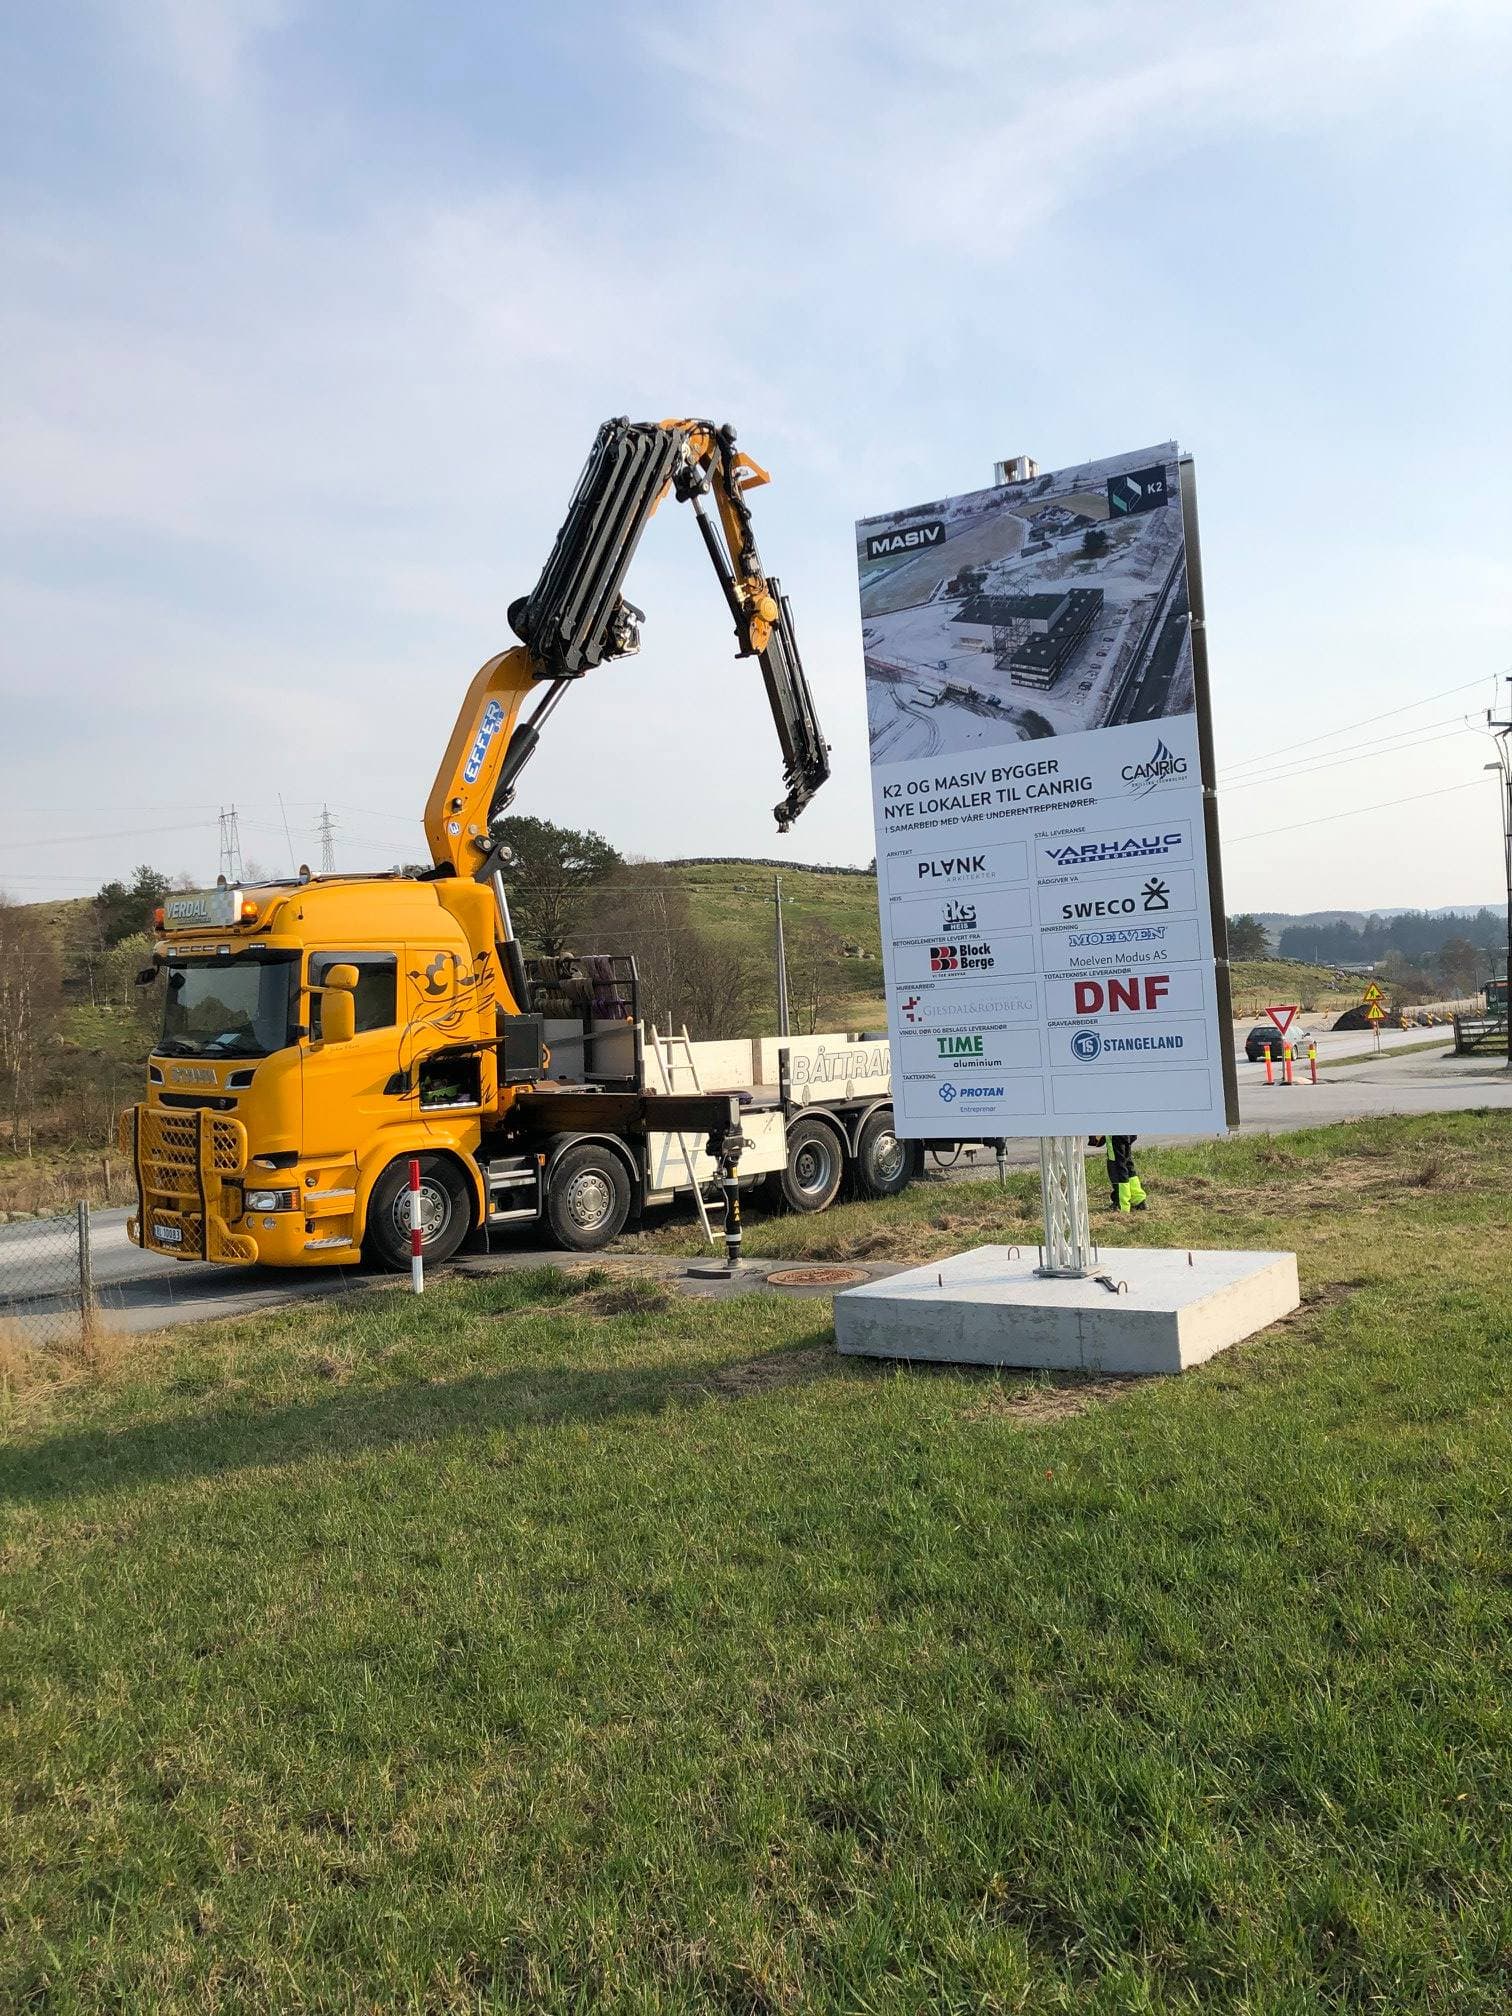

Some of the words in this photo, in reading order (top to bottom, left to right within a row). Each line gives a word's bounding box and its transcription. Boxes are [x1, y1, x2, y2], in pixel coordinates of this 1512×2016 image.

[1147, 481, 1163, 494] K2
[872, 526, 940, 555] MASIV
[465, 701, 498, 780] EFFER
[1121, 757, 1188, 781] CANRIG
[883, 784, 902, 799] K2
[907, 780, 930, 795] OG
[935, 770, 986, 792] MASIV
[991, 759, 1059, 783] BYGGER
[884, 803, 915, 820] NYE
[919, 791, 992, 815] LOKALER
[996, 787, 1021, 803] TIL
[1025, 776, 1093, 799] CANRIG
[890, 820, 938, 834] SAMARBEID
[941, 816, 959, 827] MED
[961, 812, 984, 823] VÅRE
[986, 797, 1098, 820] UNDERENTREPRENØRER:
[1034, 831, 1049, 839] STÅL
[1050, 826, 1086, 837] LEVERANSE
[1045, 833, 1182, 859] VARHAUG
[886, 849, 913, 858] ARKITEKT
[918, 855, 986, 879] PLANK
[946, 871, 997, 882] ARKITEKTER
[1038, 877, 1068, 886] RÅDGIVER
[167, 899, 208, 919] VERDAL
[1062, 898, 1136, 920] SWECO
[950, 922, 970, 930] HEIS
[1041, 924, 1079, 932] INNREDNING
[893, 937, 946, 947] BETONGELEMENTER
[1069, 927, 1166, 947] MOELVEN
[960, 943, 991, 956] Block
[961, 957, 995, 970] Berge
[1070, 955, 1113, 967] Moelven
[1115, 952, 1151, 964] Modus
[1153, 949, 1168, 960] AS
[1044, 972, 1088, 980] TOTALTEKNISK
[1089, 967, 1132, 977] LEVERANDØR
[896, 983, 936, 991] MURERARBEID
[1074, 975, 1170, 1015] DNF
[942, 1026, 967, 1034] BESLAGS
[968, 1024, 1008, 1032] LEVERANDØR
[1047, 1019, 1099, 1028] GRAVEARBEIDER
[937, 1035, 984, 1053] TIME
[1103, 1035, 1184, 1052] STANGELAND
[953, 1059, 1002, 1068] aluminium
[959, 1087, 1005, 1097] PROTAN
[960, 1105, 997, 1113] Entreprenør
